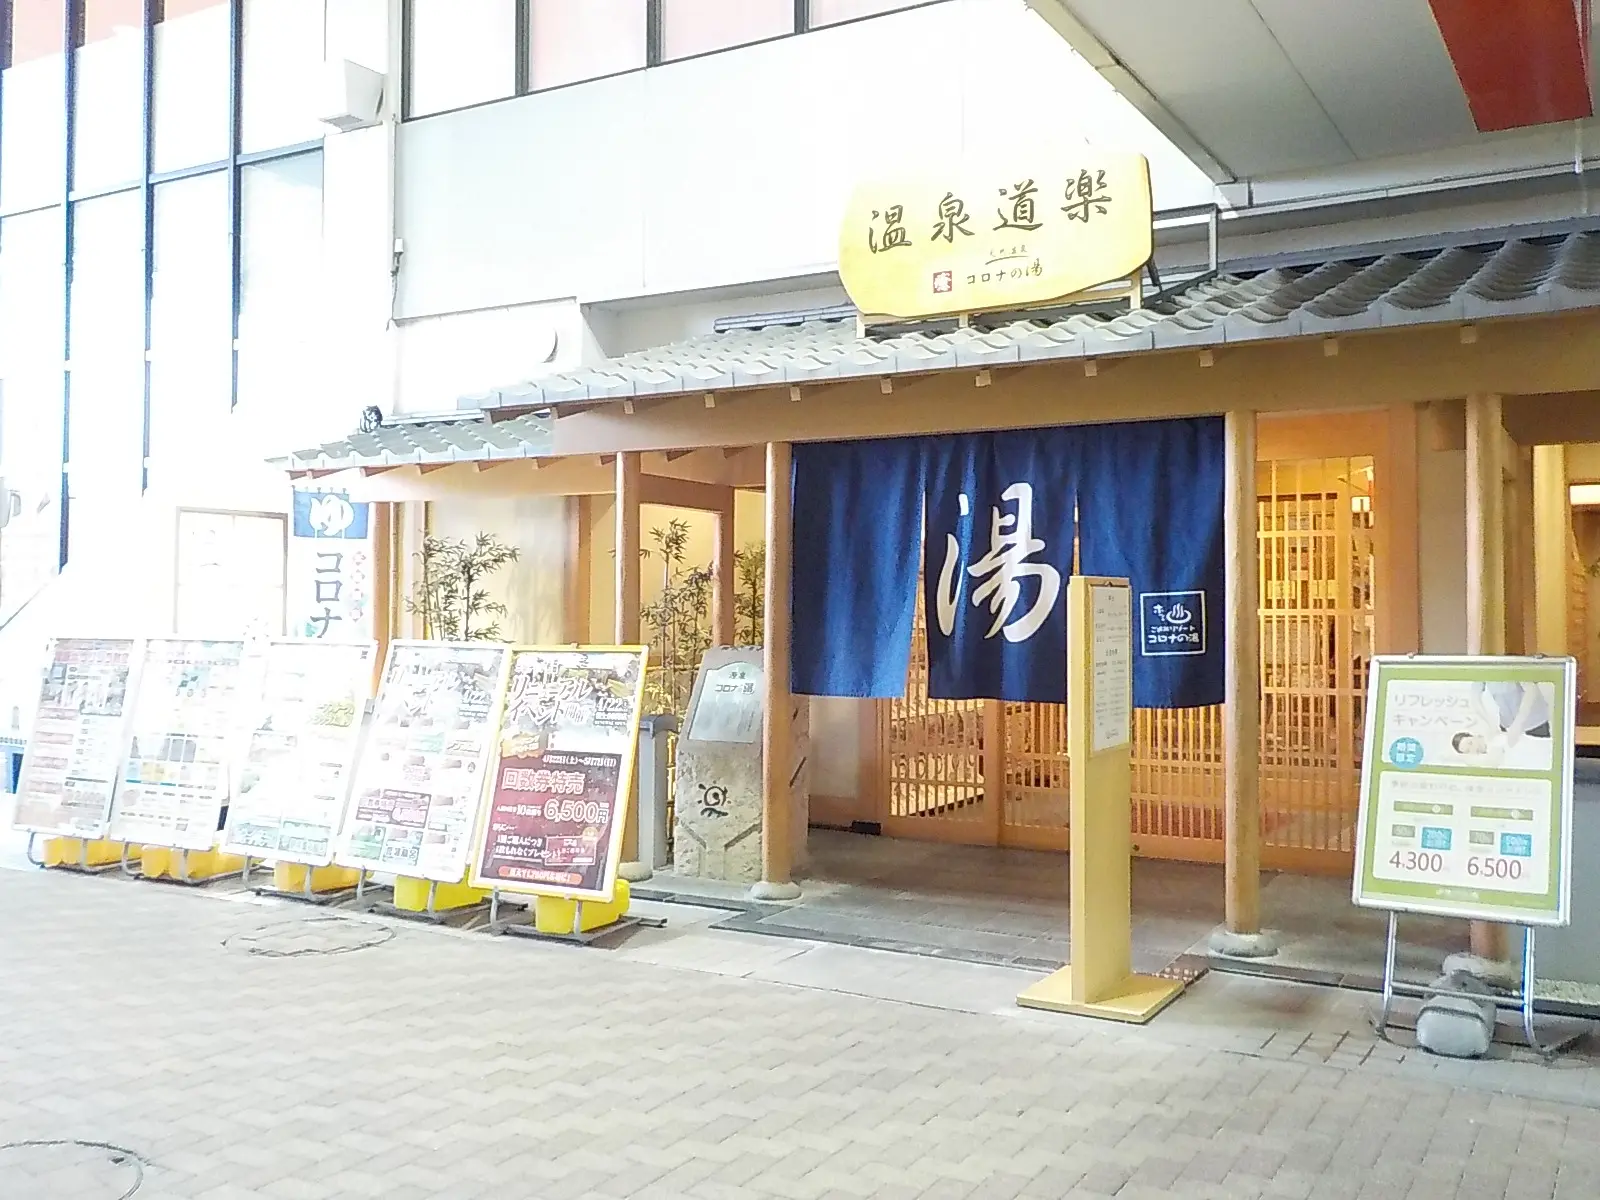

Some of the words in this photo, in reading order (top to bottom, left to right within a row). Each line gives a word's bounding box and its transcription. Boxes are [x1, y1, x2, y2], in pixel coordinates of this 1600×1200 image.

[867, 167, 1113, 255] 温泉道楽
[966, 257, 1043, 286] コロナの湯
[308, 493, 356, 537] ゆ
[935, 482, 1061, 643] 湯
[309, 551, 344, 639] コロナ
[1147, 632, 1200, 644] コロナの湯
[1394, 693, 1470, 709] リフレッシュ
[1392, 713, 1478, 728] キャンペーン
[501, 767, 585, 795] 回数券特売
